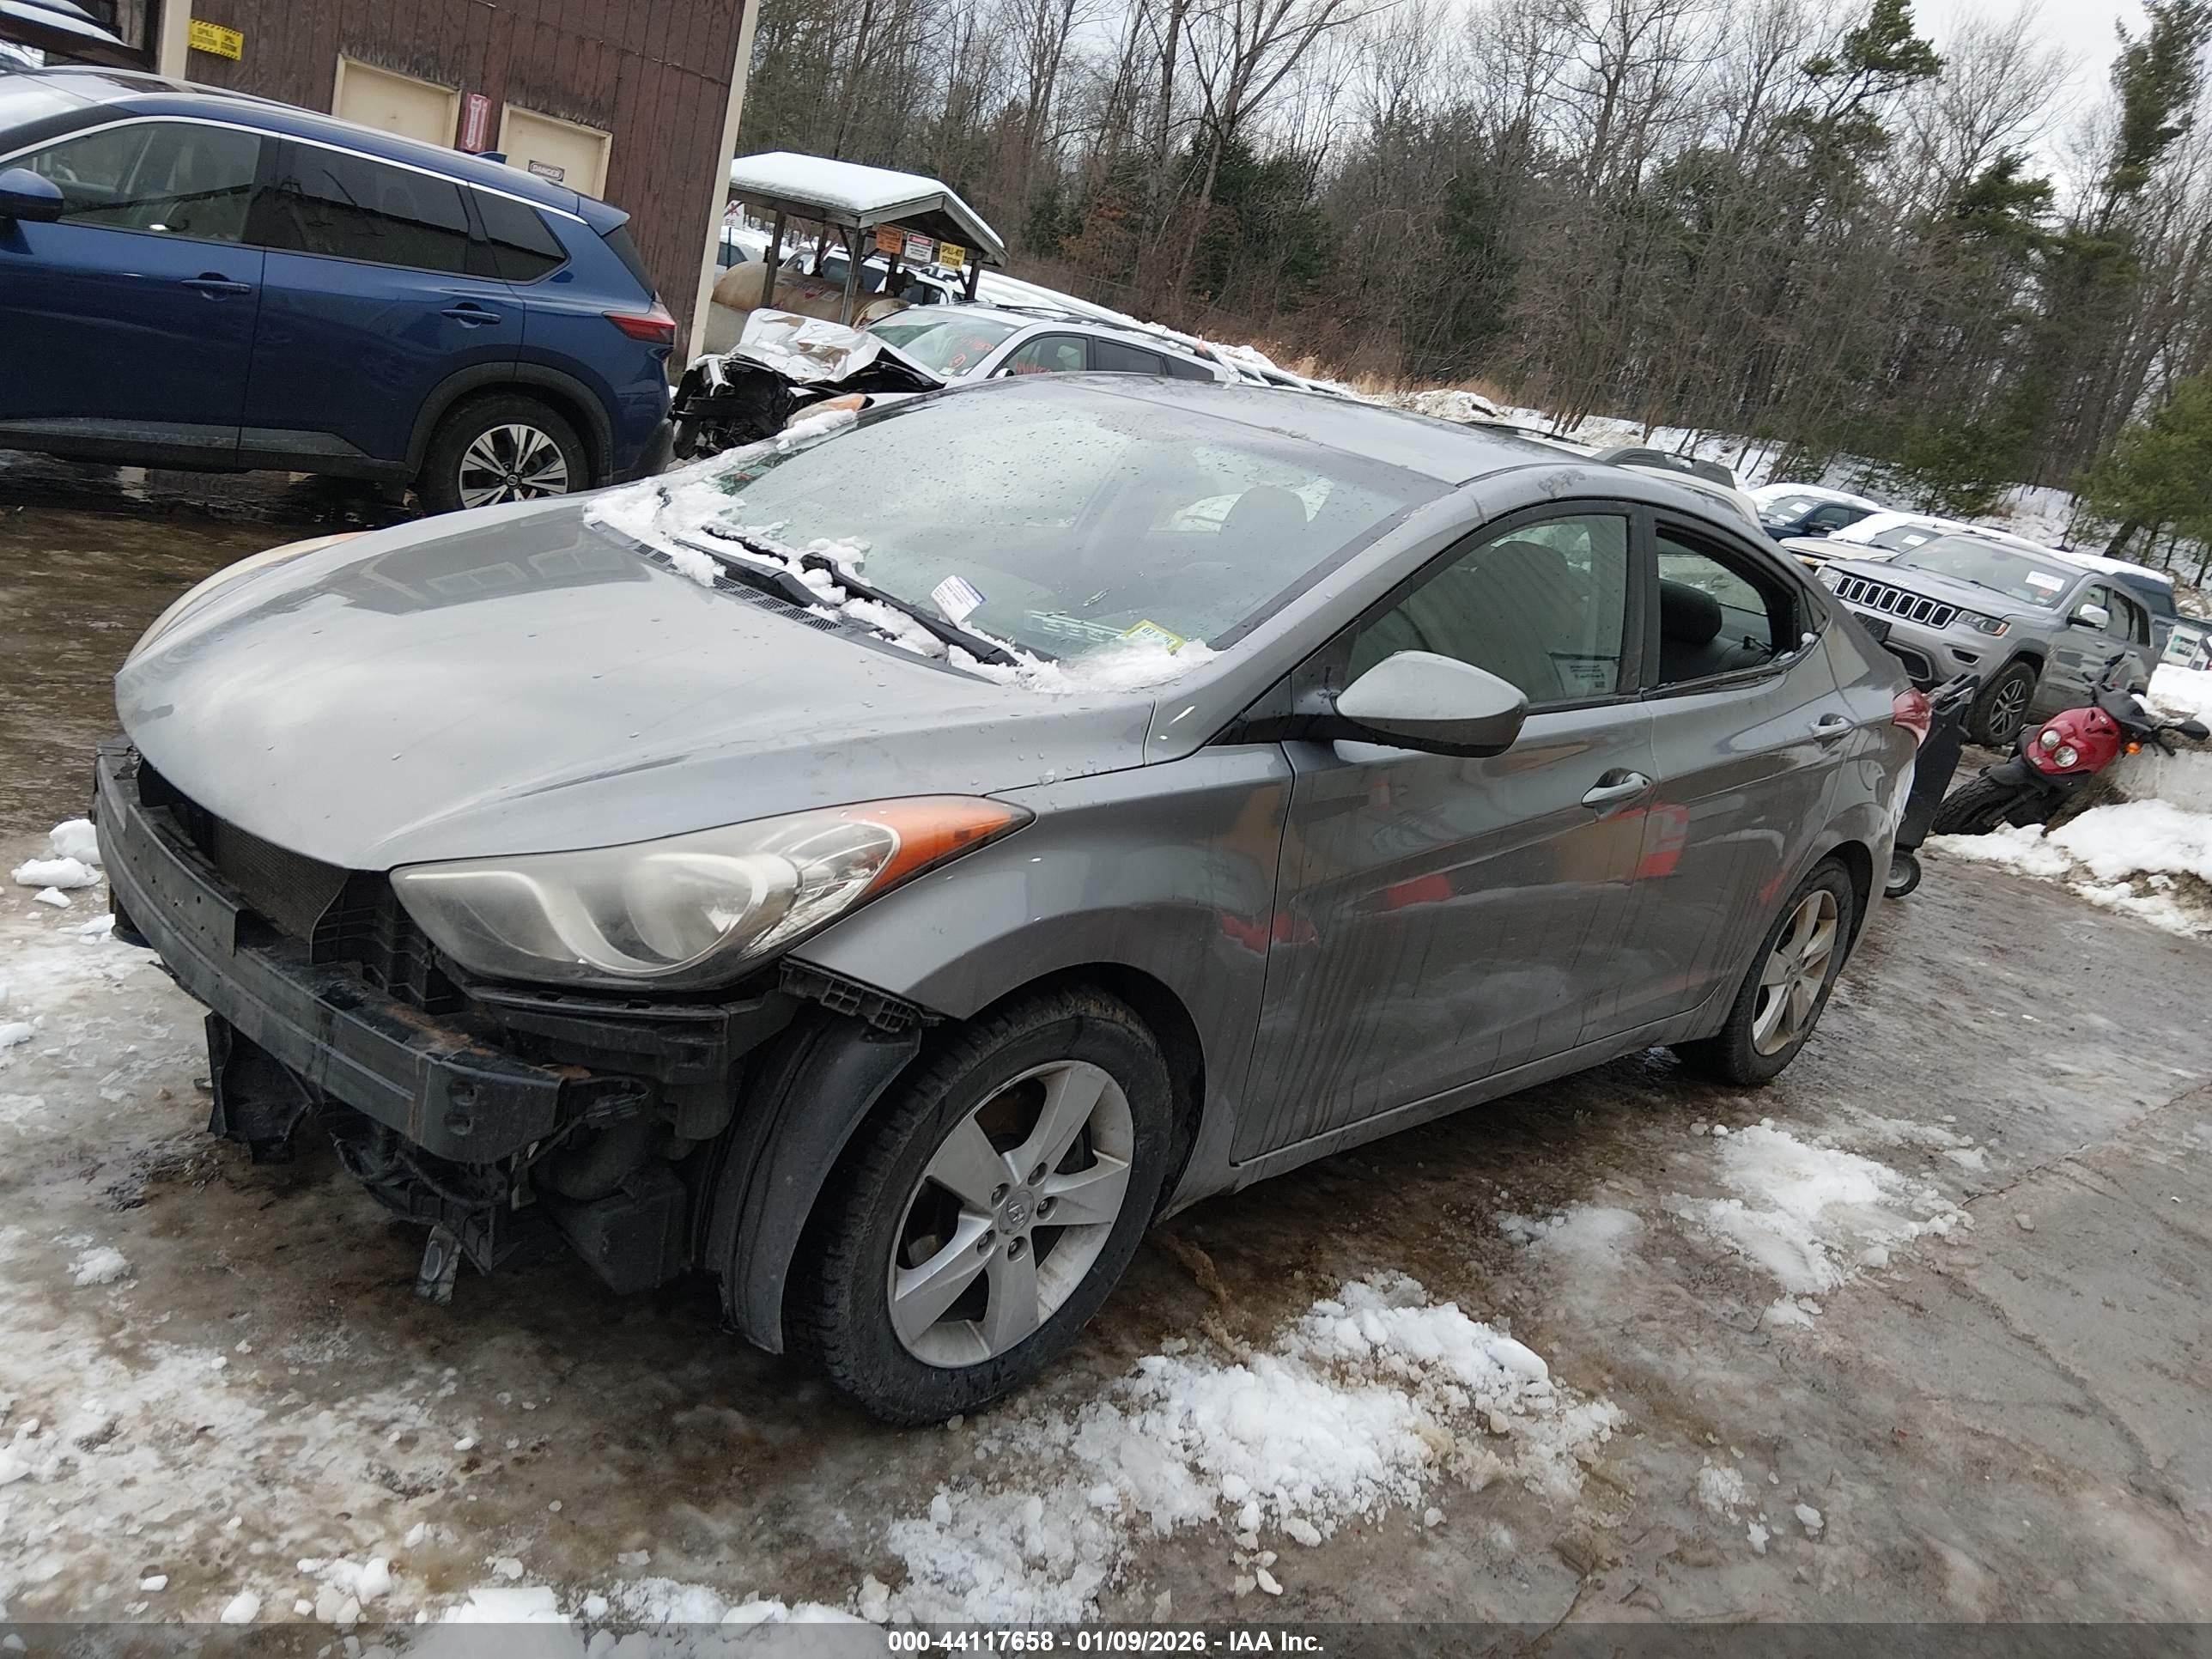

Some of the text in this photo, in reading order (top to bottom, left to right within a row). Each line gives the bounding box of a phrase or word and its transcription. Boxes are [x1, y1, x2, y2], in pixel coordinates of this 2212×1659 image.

[532, 164, 561, 177] DANGER
[942, 245, 964, 257] SPILL-KIT
[942, 256, 960, 267] STATION
